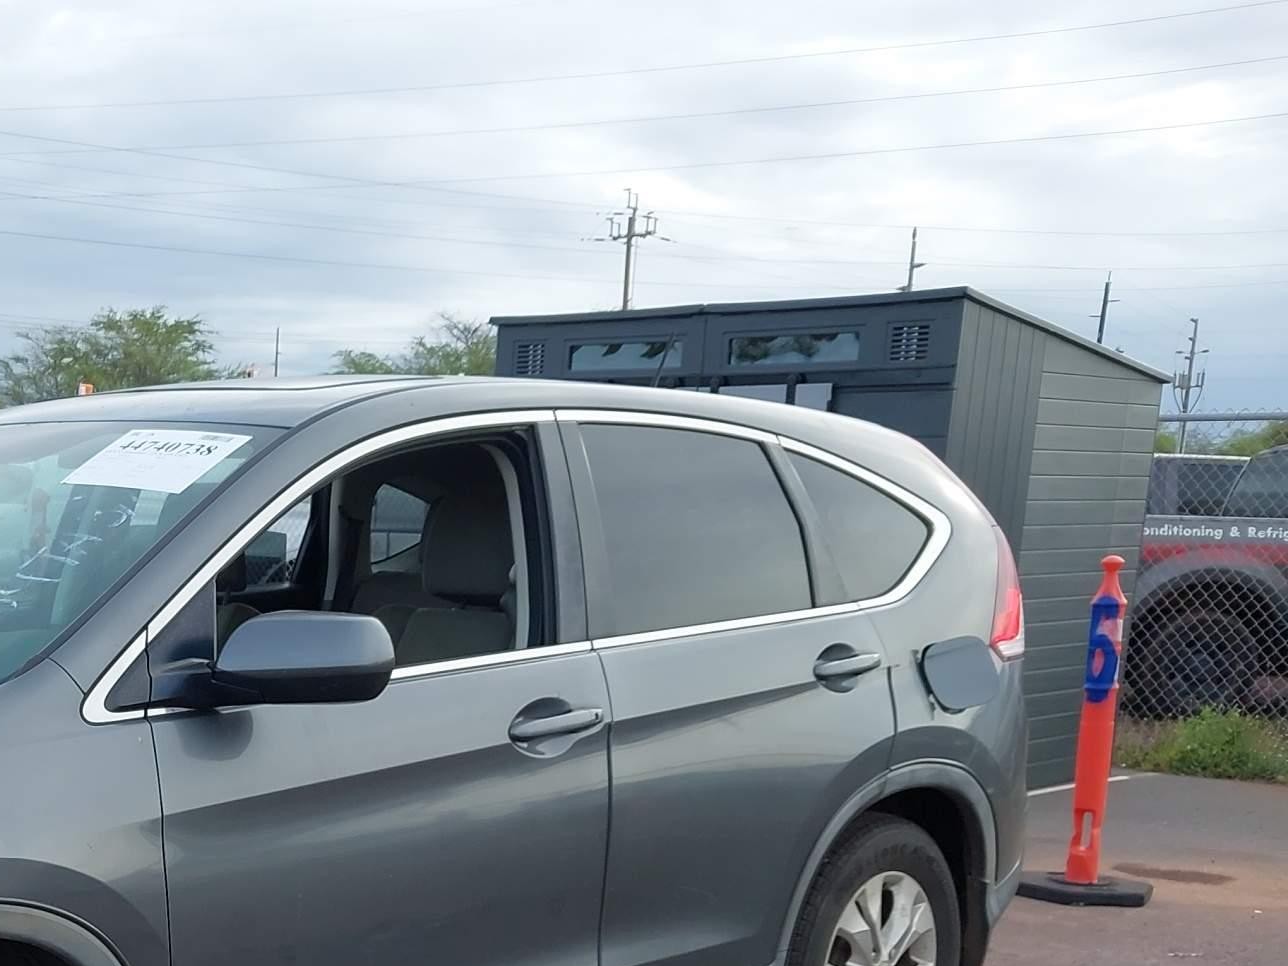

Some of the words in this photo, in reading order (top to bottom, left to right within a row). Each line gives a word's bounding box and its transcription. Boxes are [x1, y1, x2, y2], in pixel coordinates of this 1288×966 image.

[120, 440, 218, 456] 44740738
[1229, 526, 1240, 538] &
[1085, 596, 1119, 704] 6
